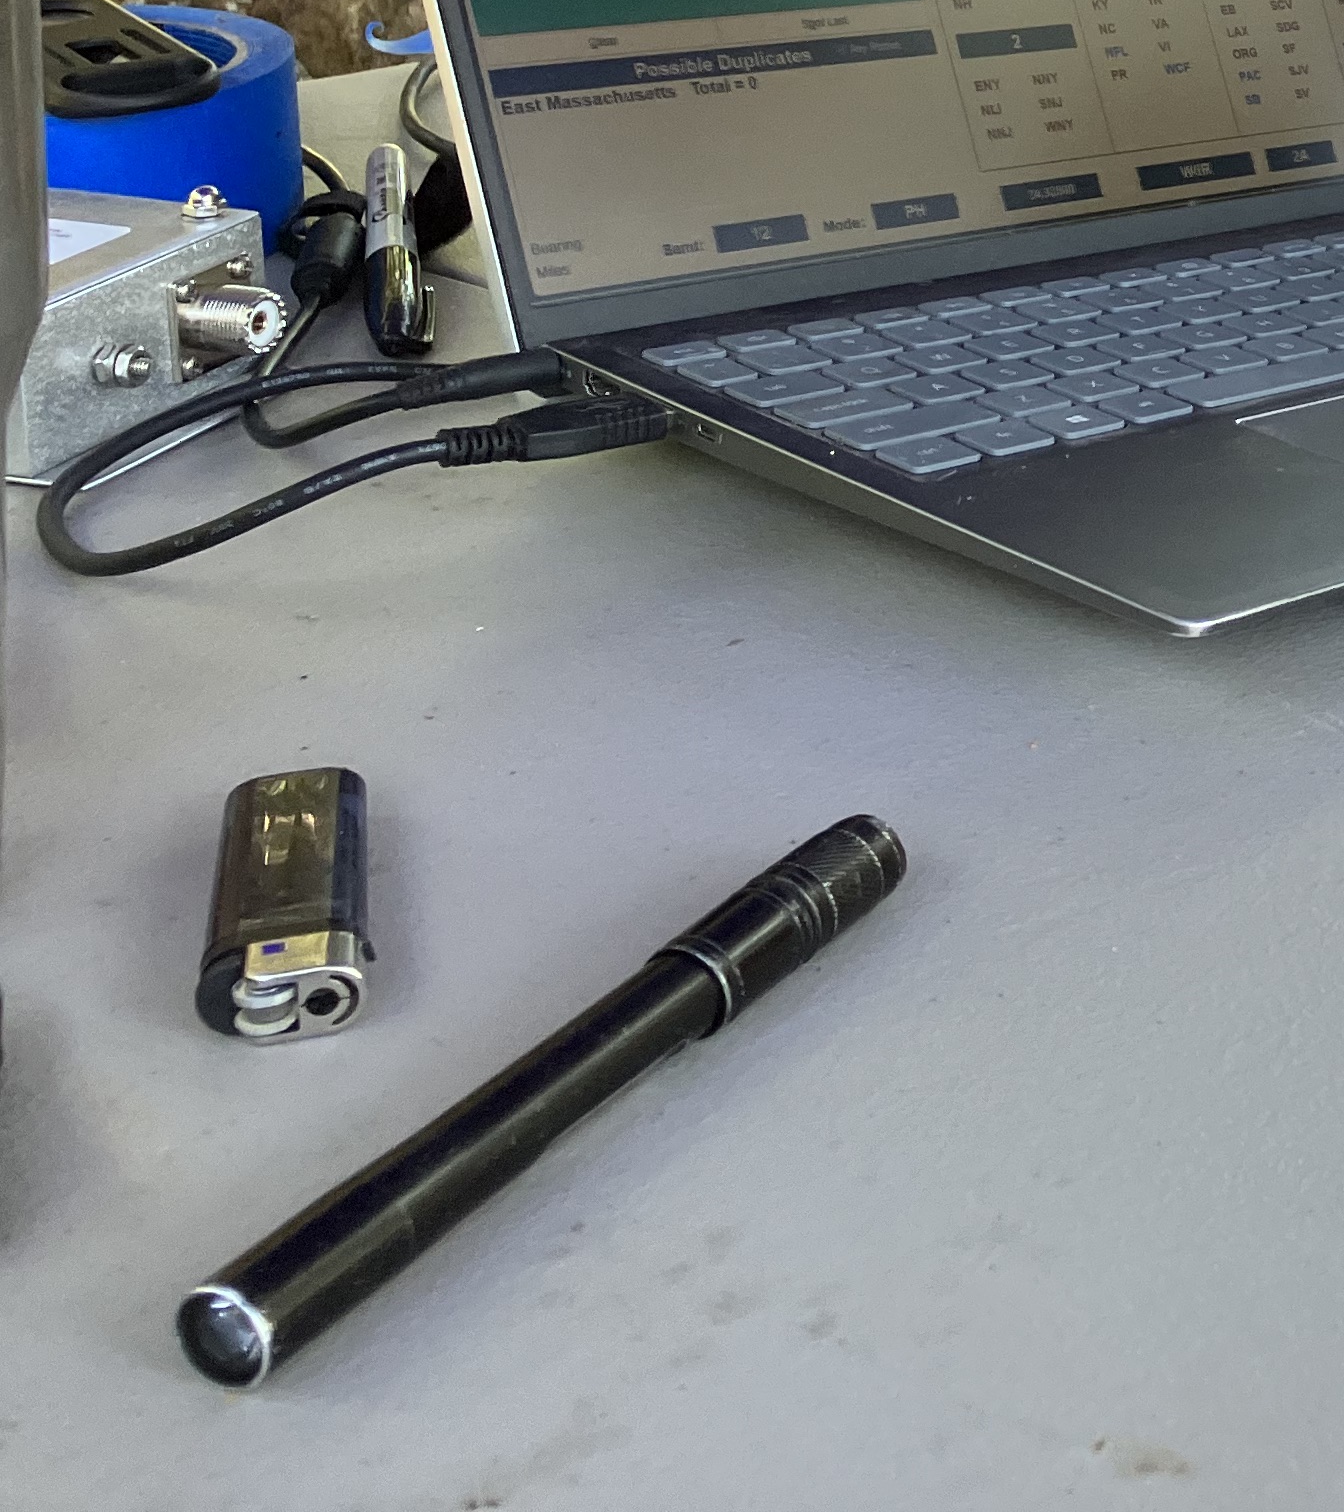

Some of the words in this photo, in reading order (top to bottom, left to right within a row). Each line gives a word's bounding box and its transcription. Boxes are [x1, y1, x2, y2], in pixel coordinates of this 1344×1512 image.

[1012, 34, 1022, 49] 2
[633, 57, 713, 79] Possible
[718, 49, 813, 75] Duplicates
[501, 98, 542, 117] East
[547, 85, 676, 112] Massachusetts
